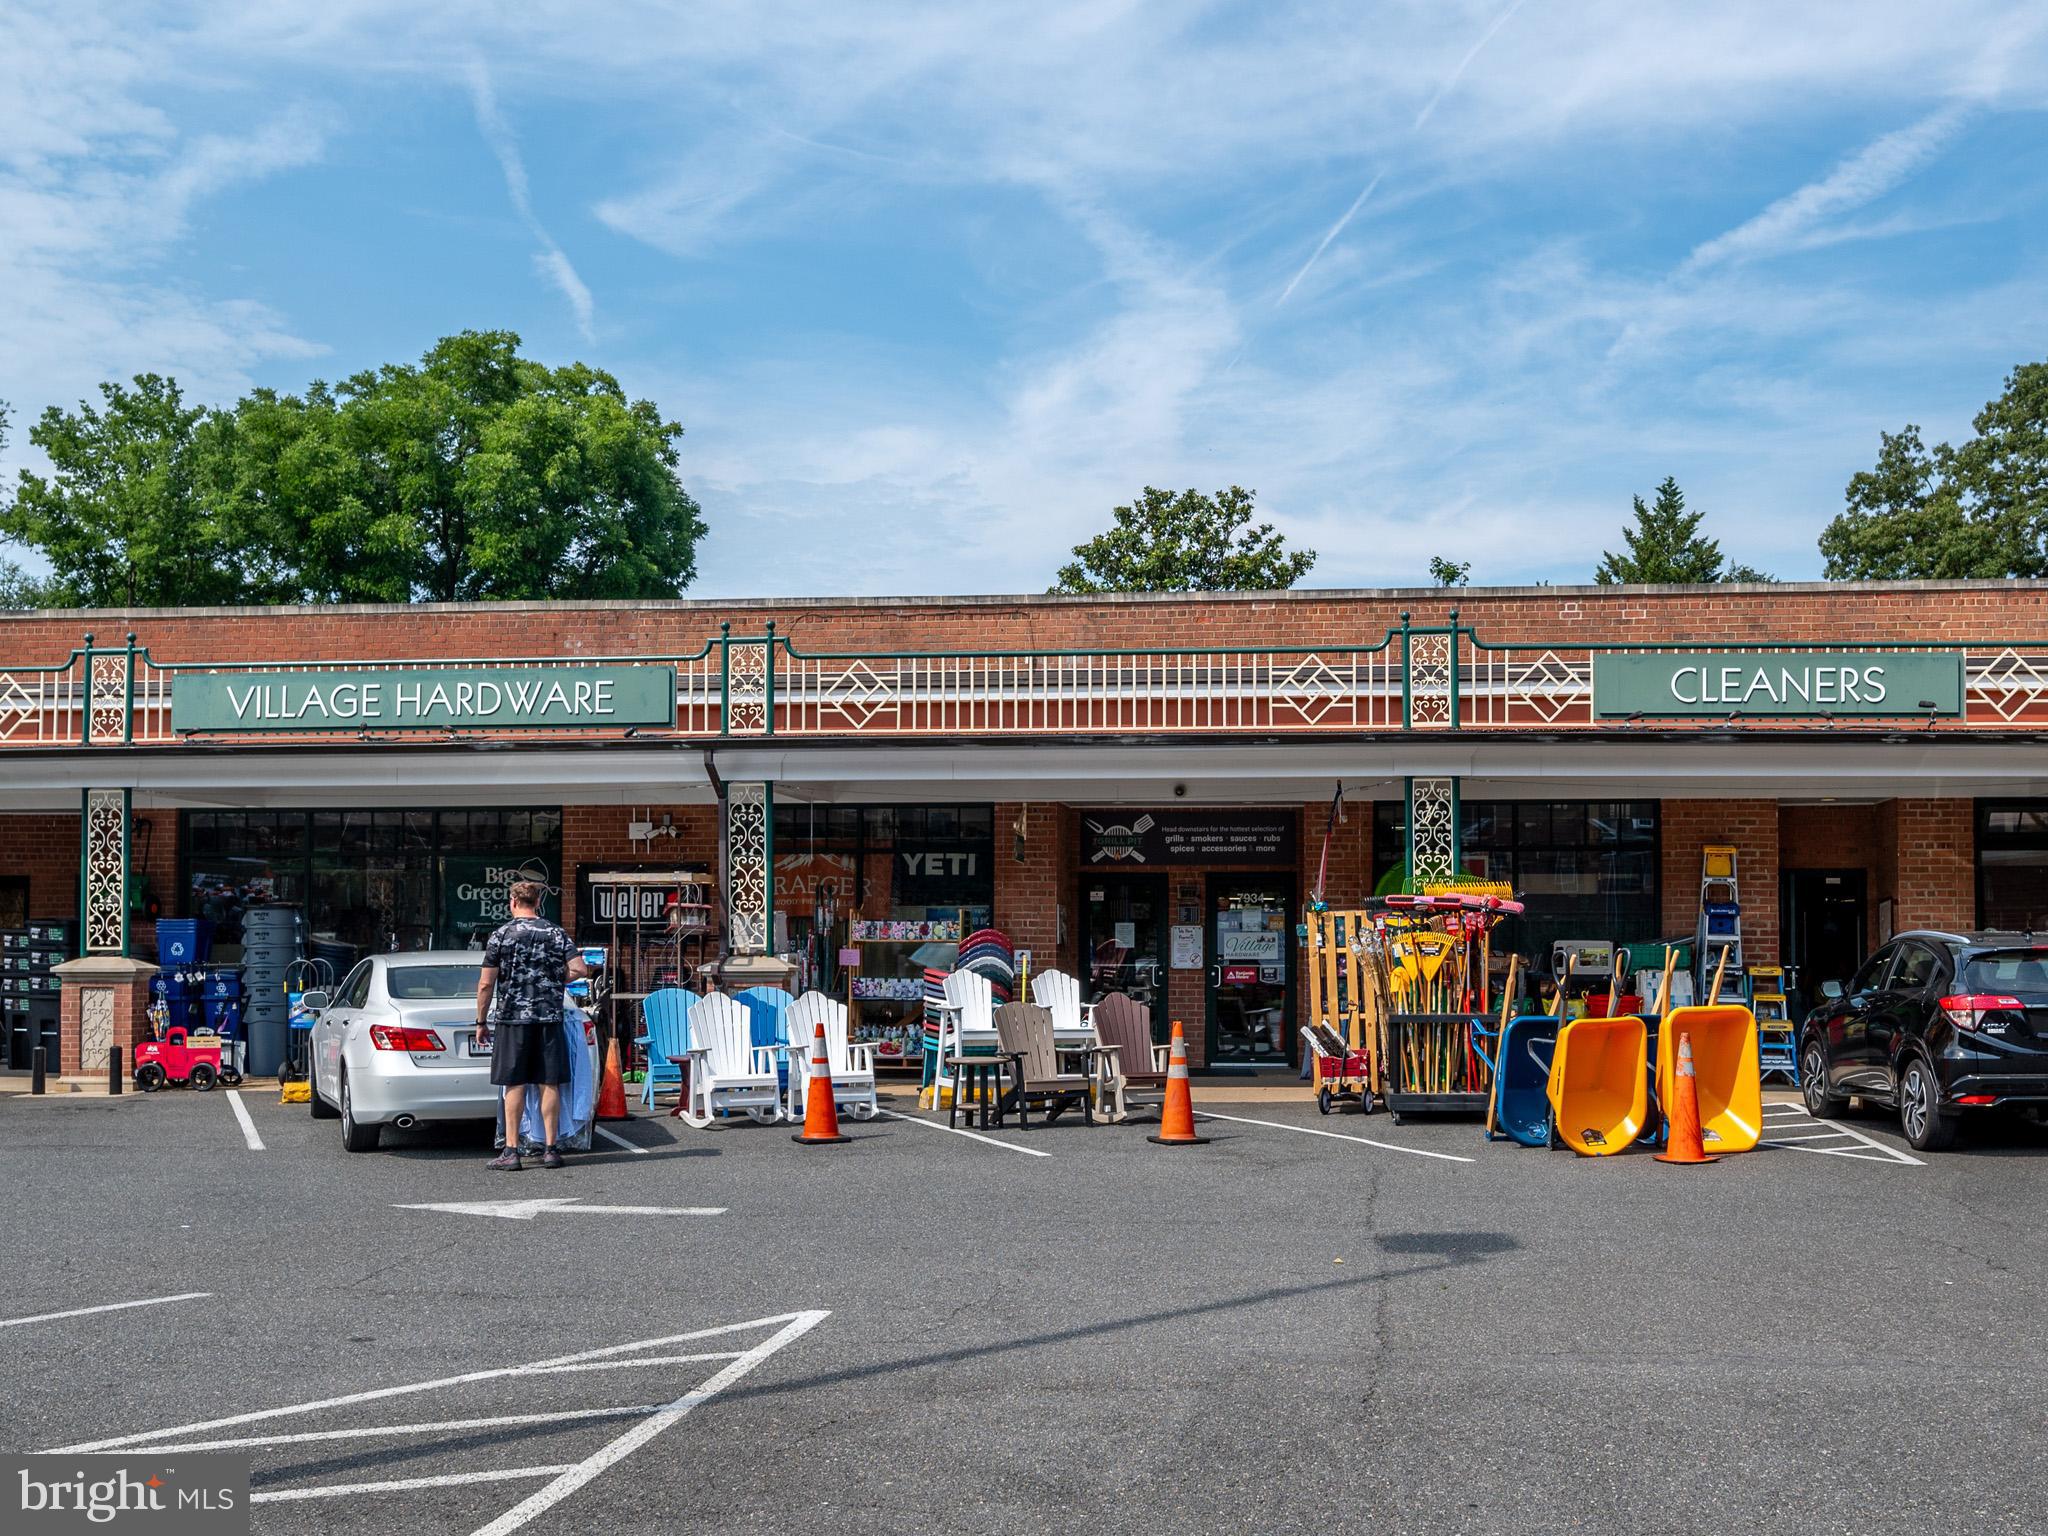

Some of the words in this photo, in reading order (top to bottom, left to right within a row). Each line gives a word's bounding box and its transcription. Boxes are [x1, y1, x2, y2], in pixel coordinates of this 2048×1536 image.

[1671, 666, 1886, 704] CLEANERS
[227, 684, 381, 719] VILLAGE
[396, 680, 615, 717] HARDWARE
[1165, 835, 1184, 844] grills
[1190, 834, 1224, 842] smokers
[1263, 834, 1281, 842] rubs
[1170, 845, 1195, 853] spices
[902, 853, 976, 876] YETI
[485, 867, 515, 888] Big
[773, 875, 873, 897] RAEGER
[600, 885, 665, 919] weber
[1237, 893, 1264, 904] 7934
[480, 901, 514, 921] Egg
[1226, 936, 1276, 953] Village
